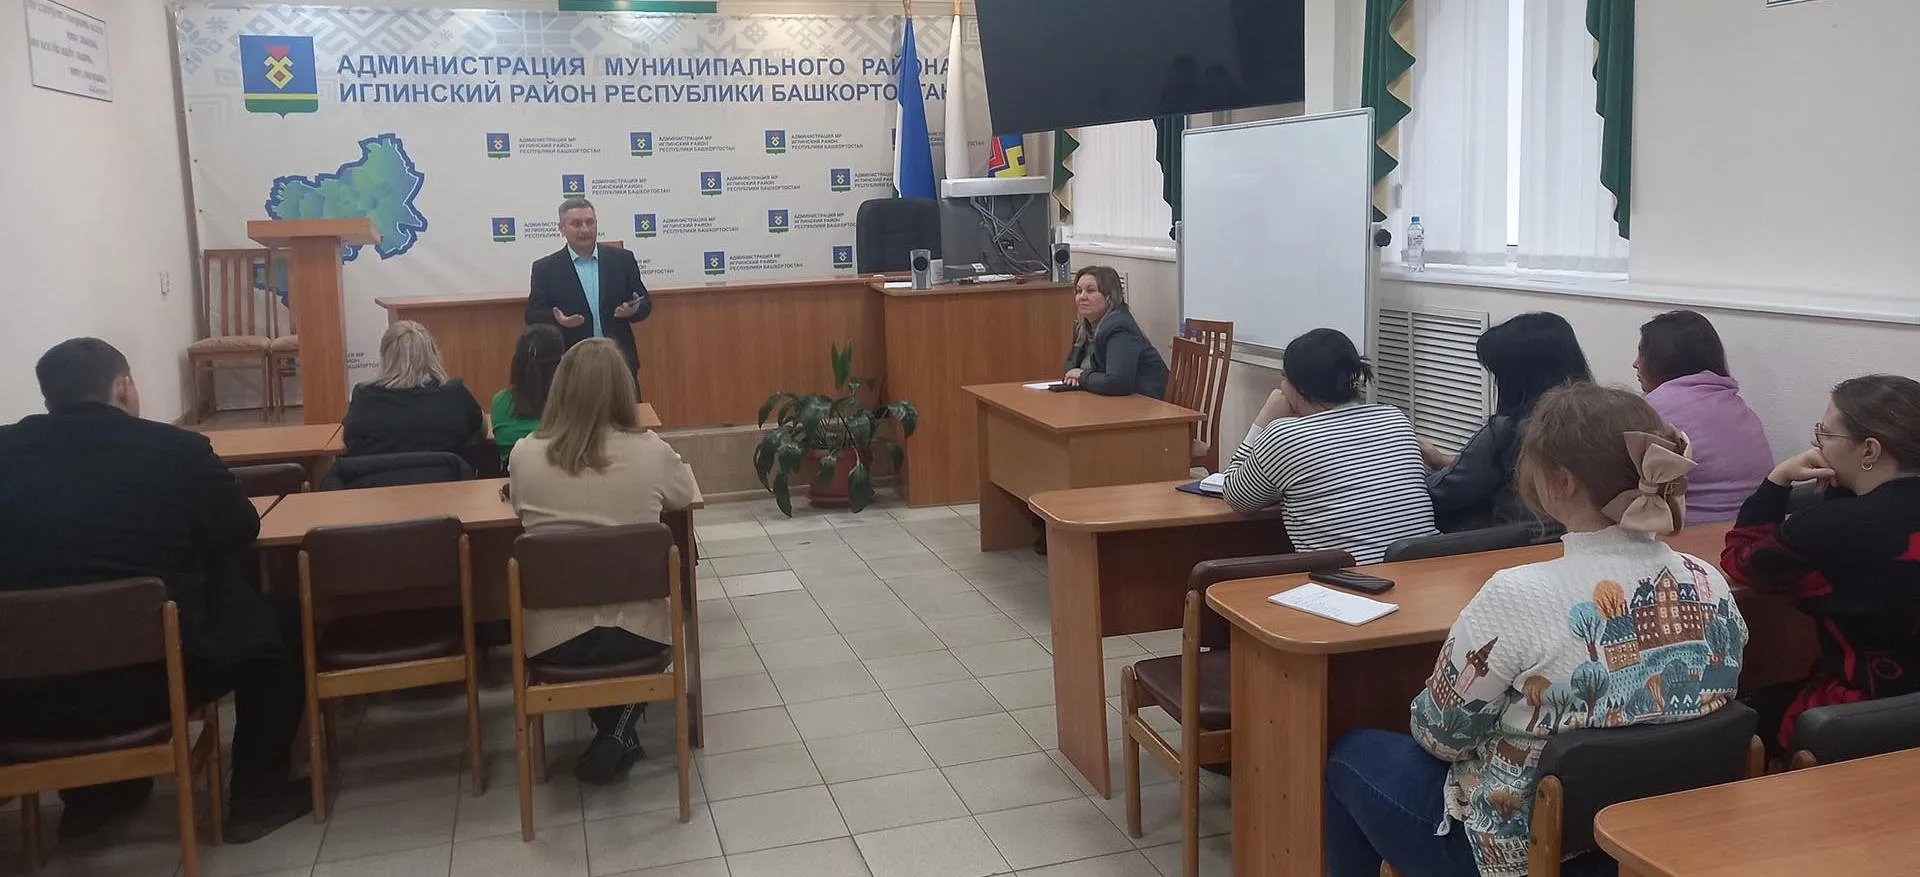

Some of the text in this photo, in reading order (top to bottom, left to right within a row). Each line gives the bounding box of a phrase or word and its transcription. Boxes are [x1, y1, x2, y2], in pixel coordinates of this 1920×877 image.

[337, 55, 585, 78] АДМИНИСТРАЦИЯ
[605, 57, 845, 79] МУНИЦИПАЛЬНОГО
[339, 80, 501, 102] ИГЛИНСКИЙ
[510, 80, 596, 103] РАЙОН
[605, 84, 764, 103] РЕСПУБЛИКИ
